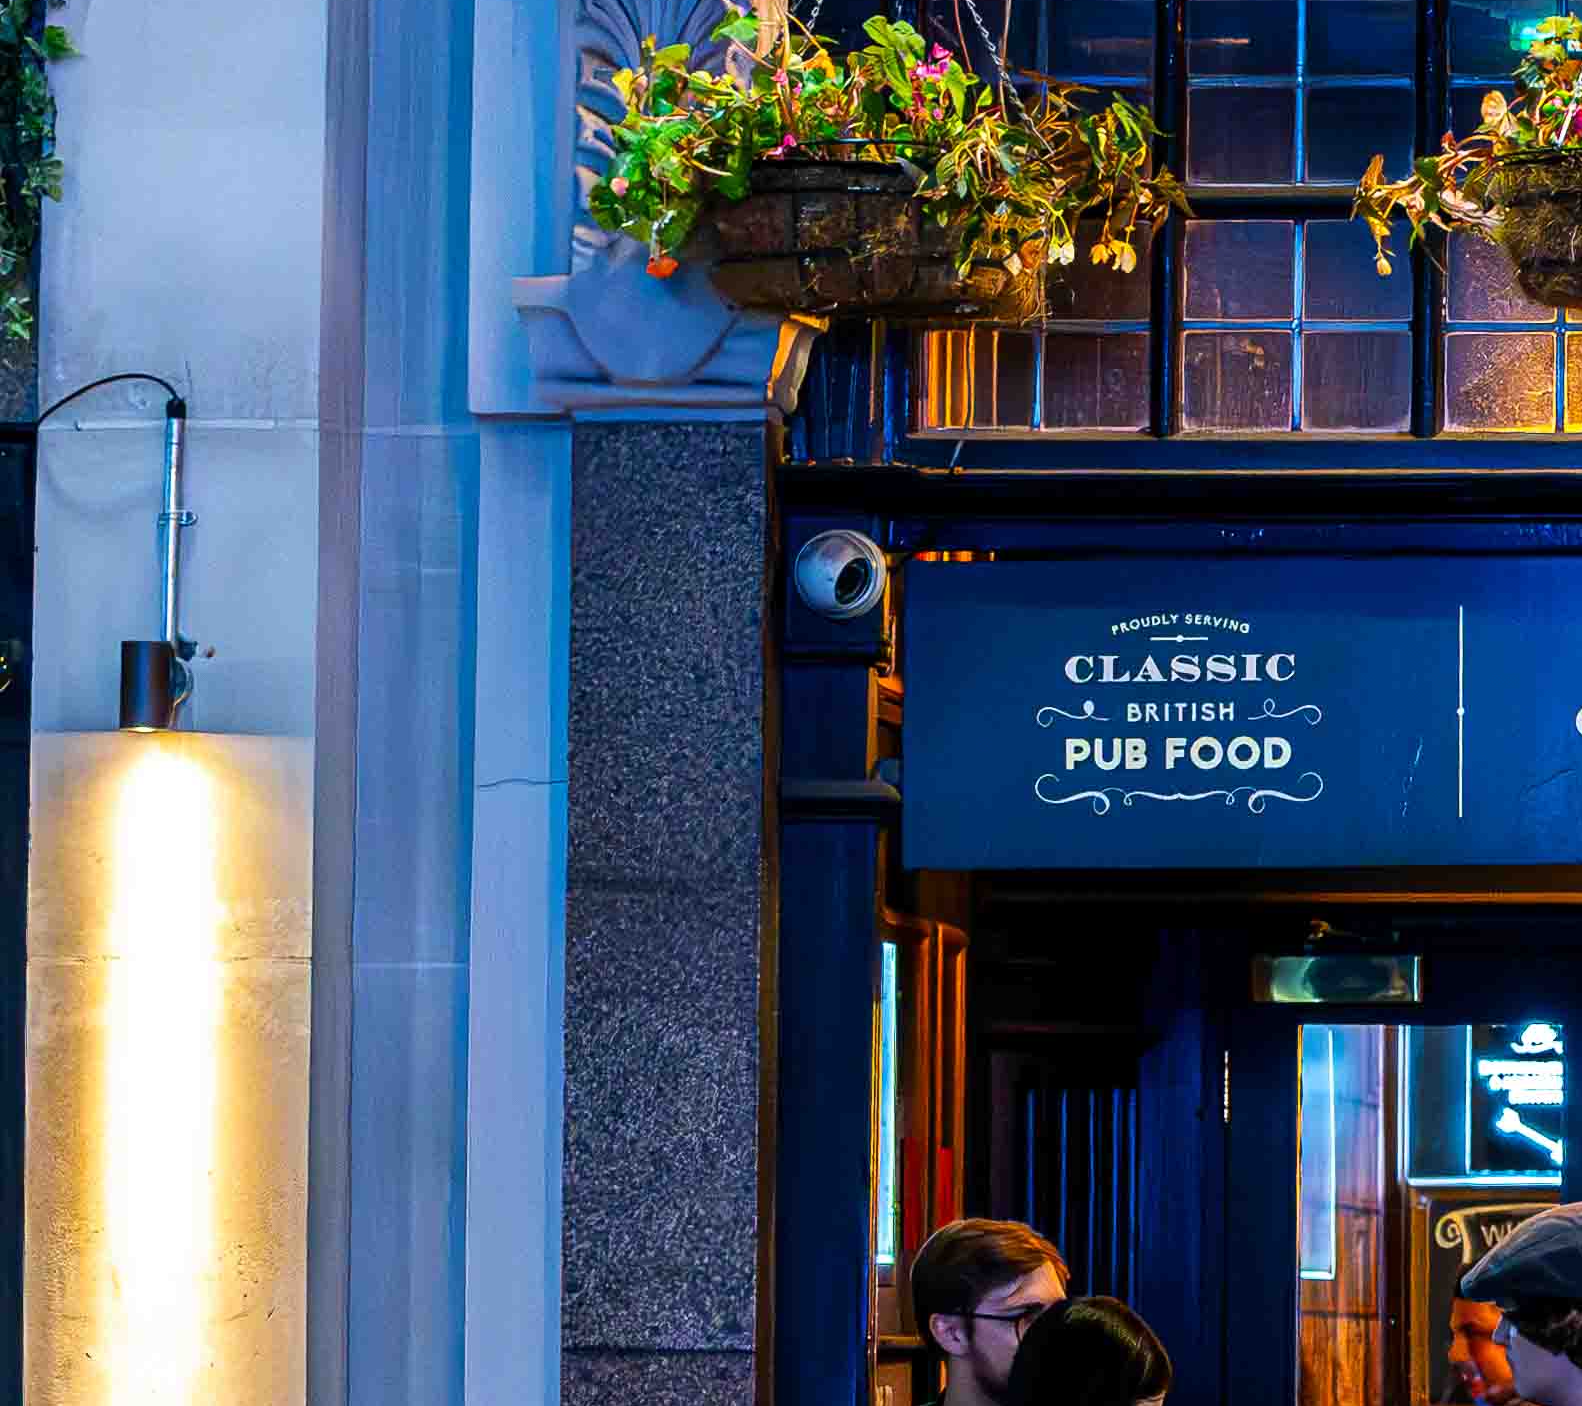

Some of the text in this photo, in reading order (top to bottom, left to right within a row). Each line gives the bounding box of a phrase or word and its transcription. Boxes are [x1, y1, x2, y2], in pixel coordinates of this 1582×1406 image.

[1111, 613, 1251, 636] PROUDLY SERVING
[1063, 653, 1296, 683] CLASSIC
[1126, 701, 1235, 722] BRITISH
[1064, 735, 1292, 770] PUB FOOD
